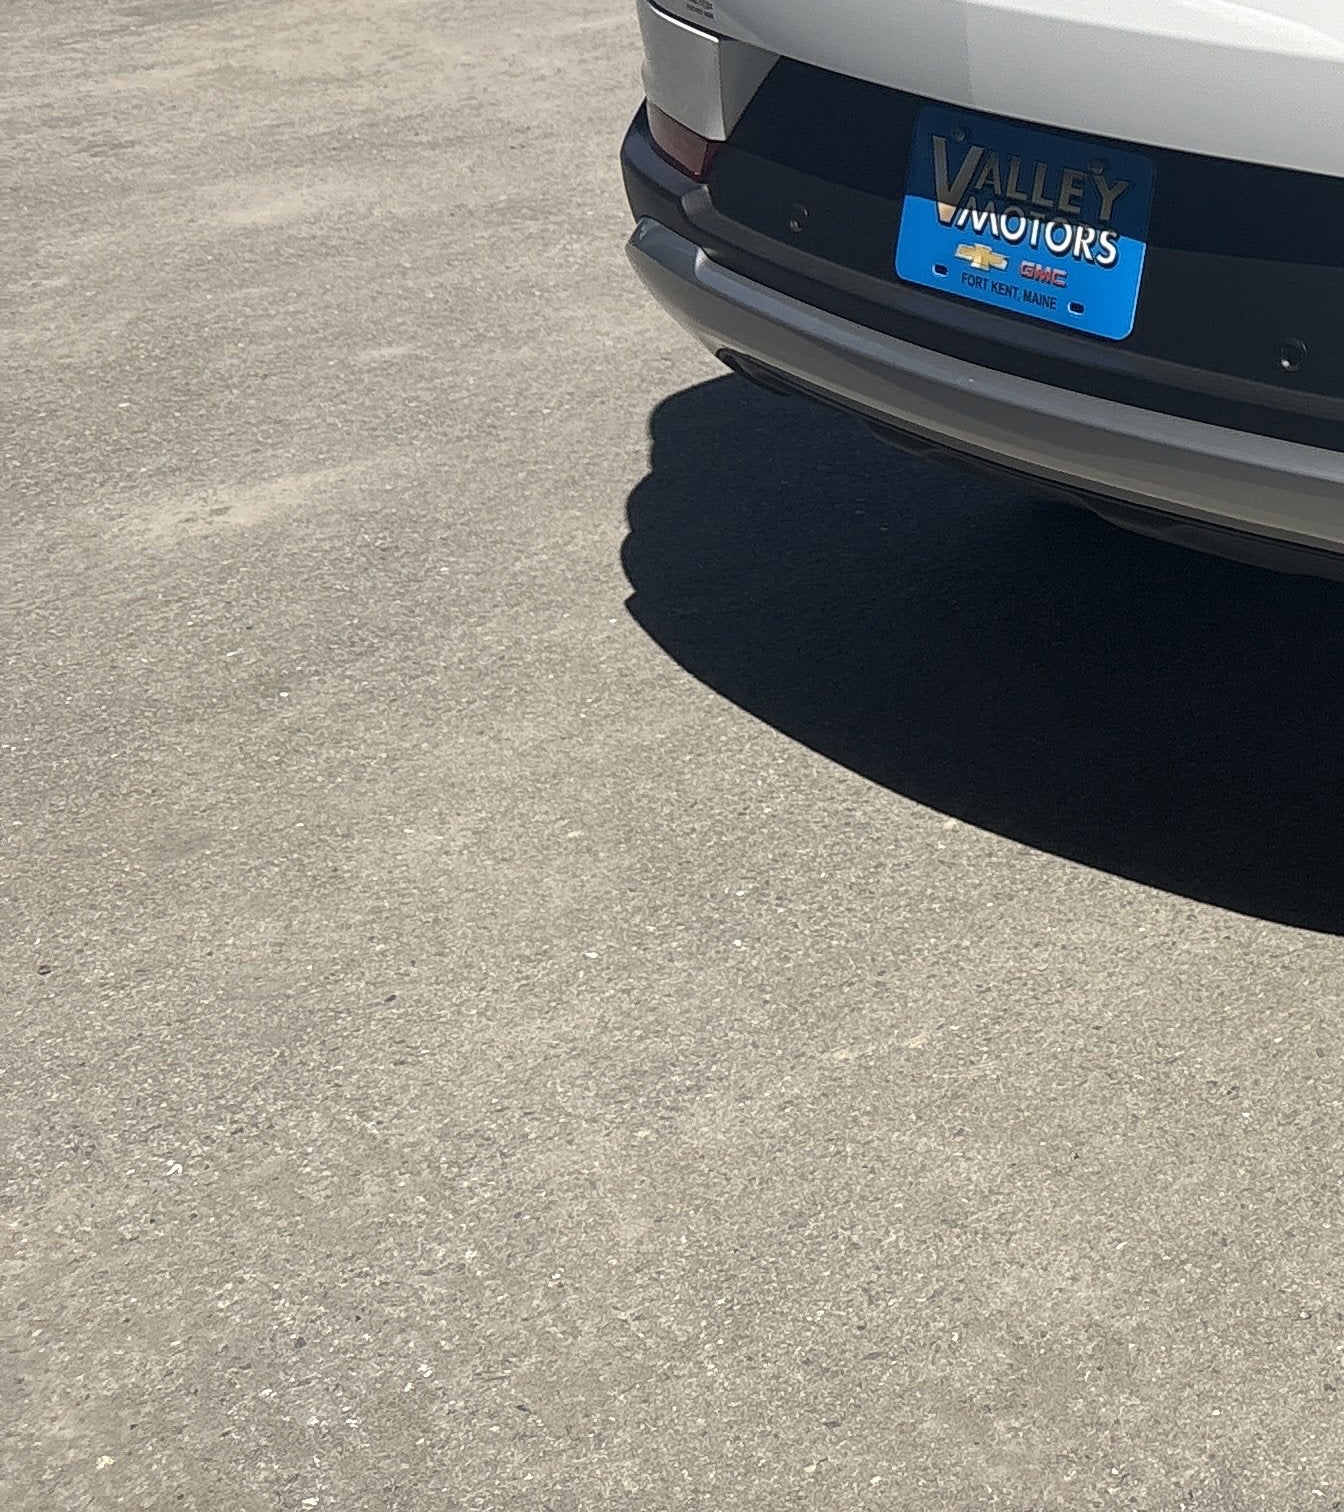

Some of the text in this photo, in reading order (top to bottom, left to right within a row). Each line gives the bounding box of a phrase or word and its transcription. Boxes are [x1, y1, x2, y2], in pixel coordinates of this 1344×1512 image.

[931, 134, 1132, 225] VALLEY
[956, 195, 1121, 268] MOTORS
[961, 271, 988, 290] FORT
[1023, 288, 1058, 311] MAINE
[1019, 259, 1069, 287] GMC
